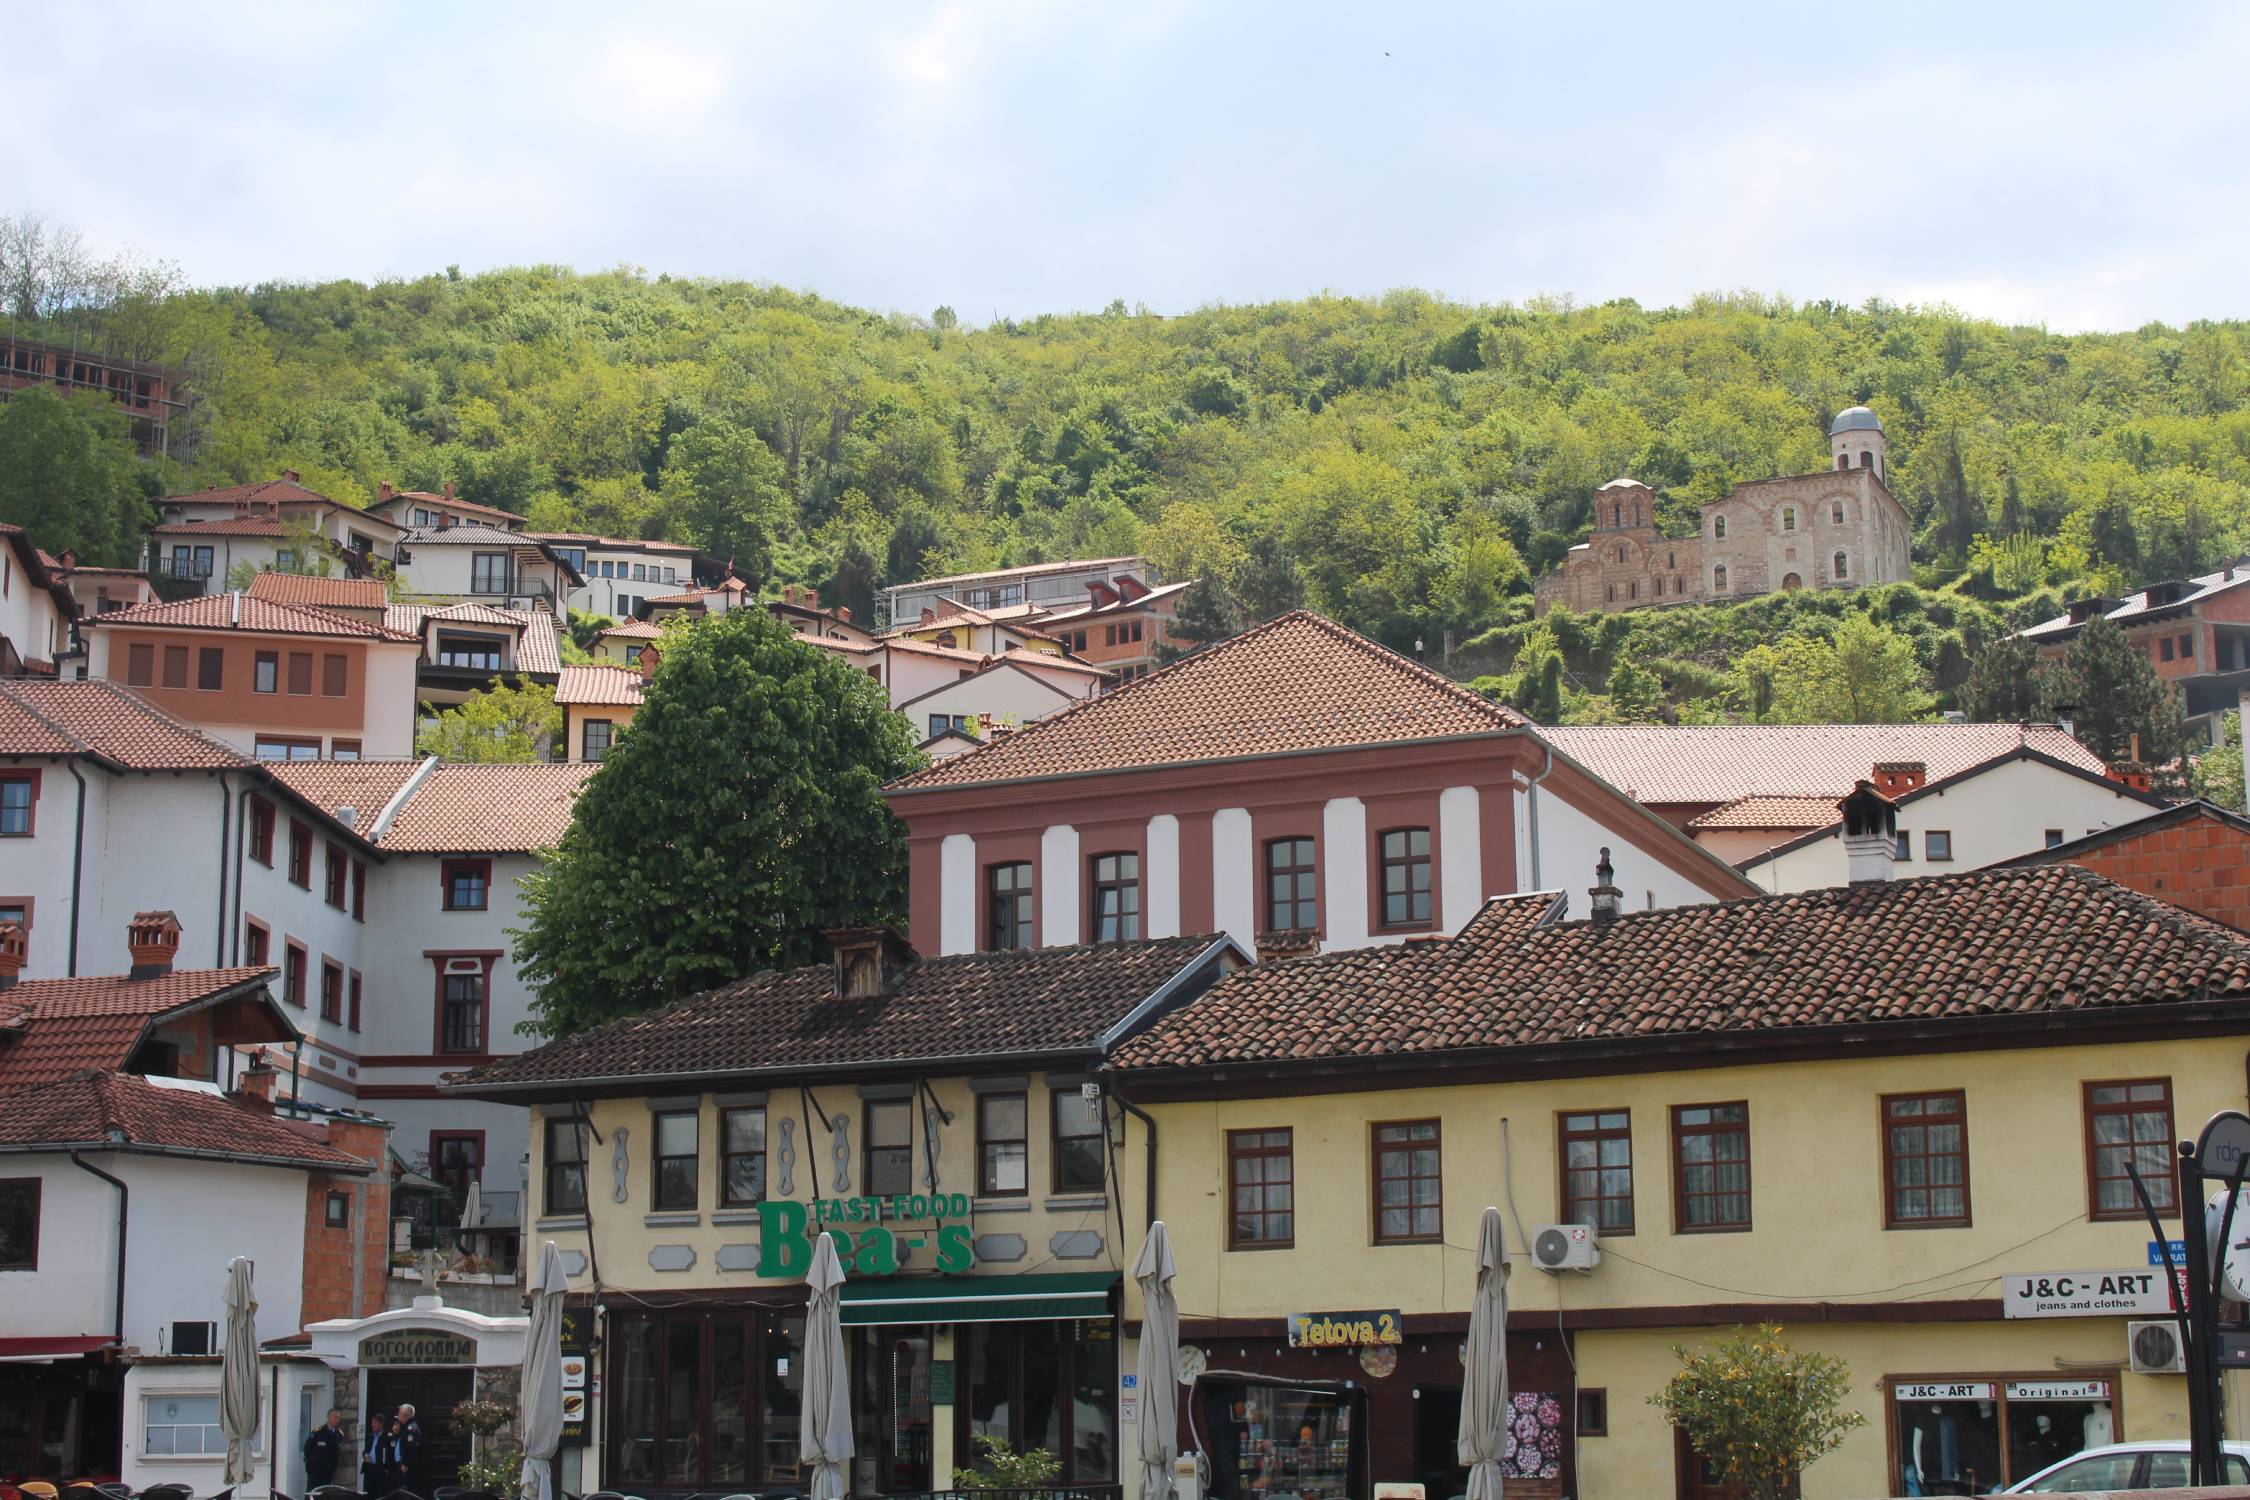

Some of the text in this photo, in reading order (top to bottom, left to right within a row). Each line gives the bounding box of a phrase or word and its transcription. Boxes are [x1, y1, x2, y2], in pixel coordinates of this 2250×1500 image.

[814, 1193, 970, 1224] FAST FOOD
[2018, 1278, 2075, 1299] J&C
[2098, 1274, 2153, 1296] ART
[2036, 1299, 2136, 1312] jeans and clothes
[1296, 1313, 1395, 1345] Tetova 2
[1123, 1375, 1137, 1388] 42
[1909, 1385, 1937, 1398] J&C
[1948, 1385, 1975, 1397] ART
[2019, 1387, 2086, 1399] Original
